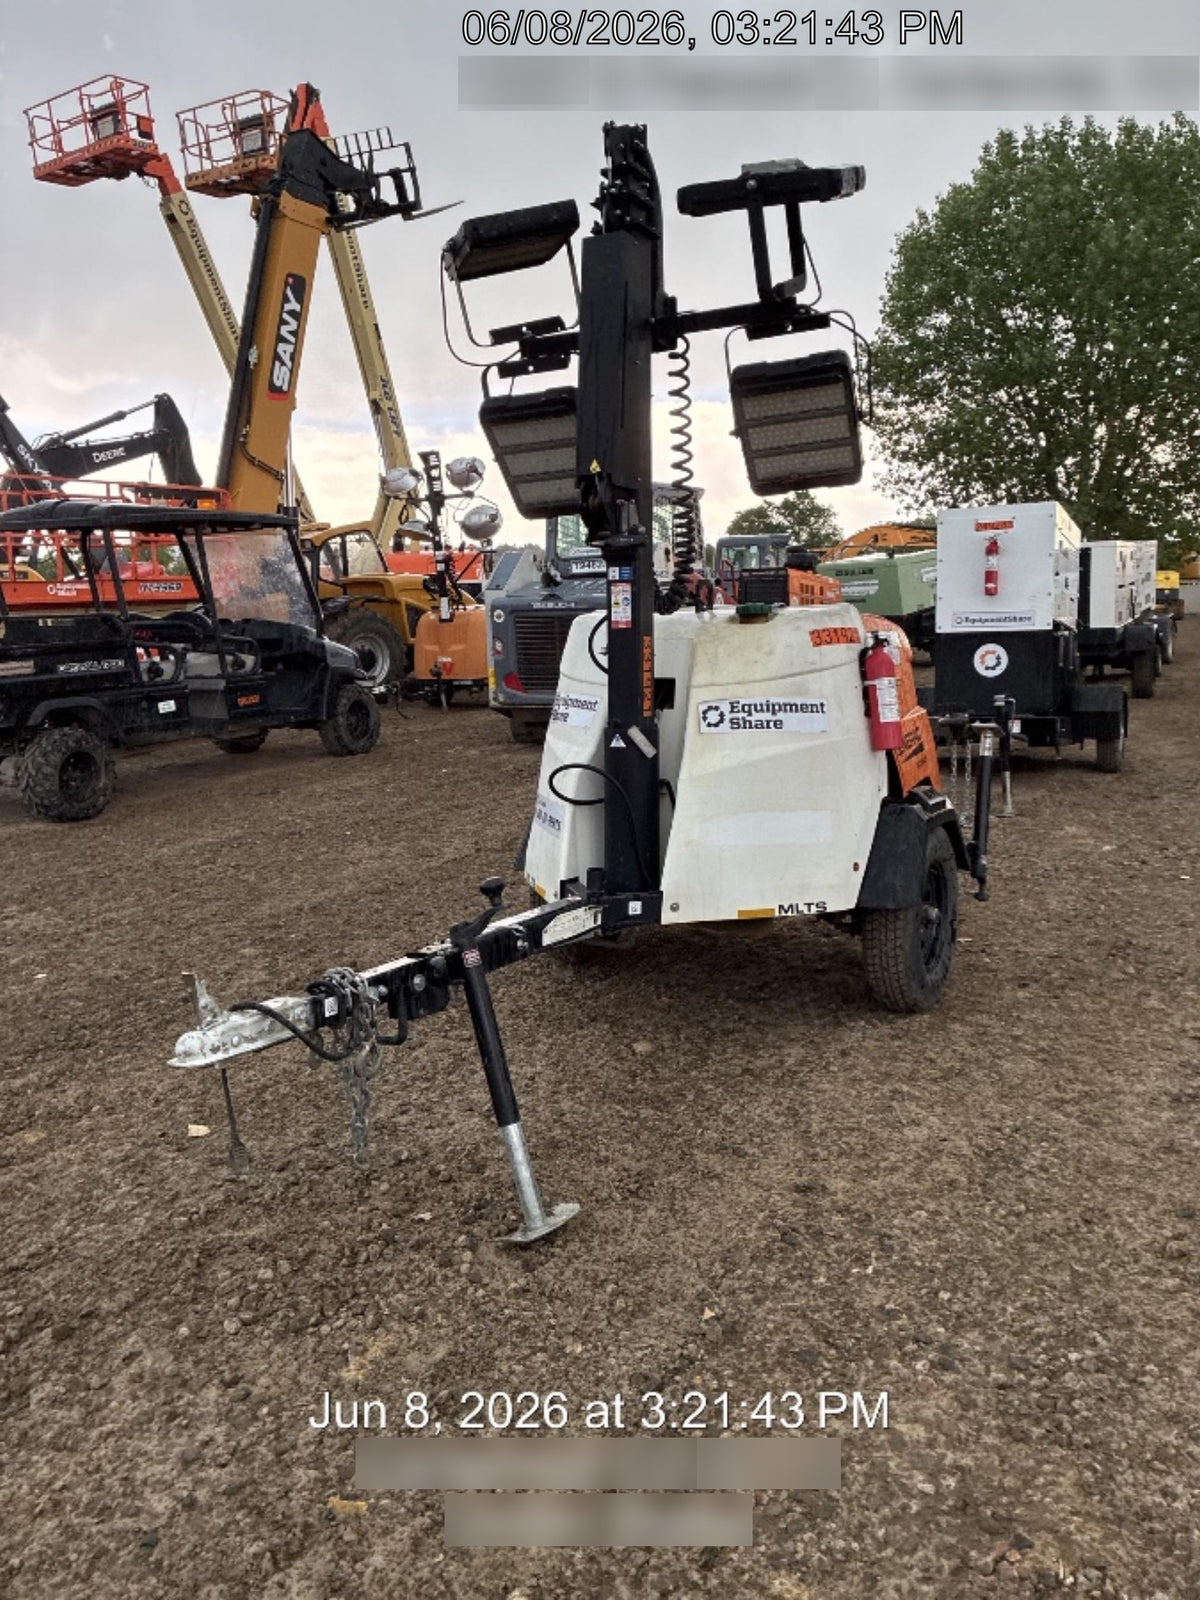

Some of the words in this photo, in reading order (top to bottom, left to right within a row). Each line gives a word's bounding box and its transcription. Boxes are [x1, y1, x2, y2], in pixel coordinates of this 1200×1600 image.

[272, 286, 300, 392] SANY
[92, 446, 126, 463] DEERE
[728, 700, 826, 716] Equipment
[728, 717, 783, 730] Share
[778, 901, 828, 915] MLTS
